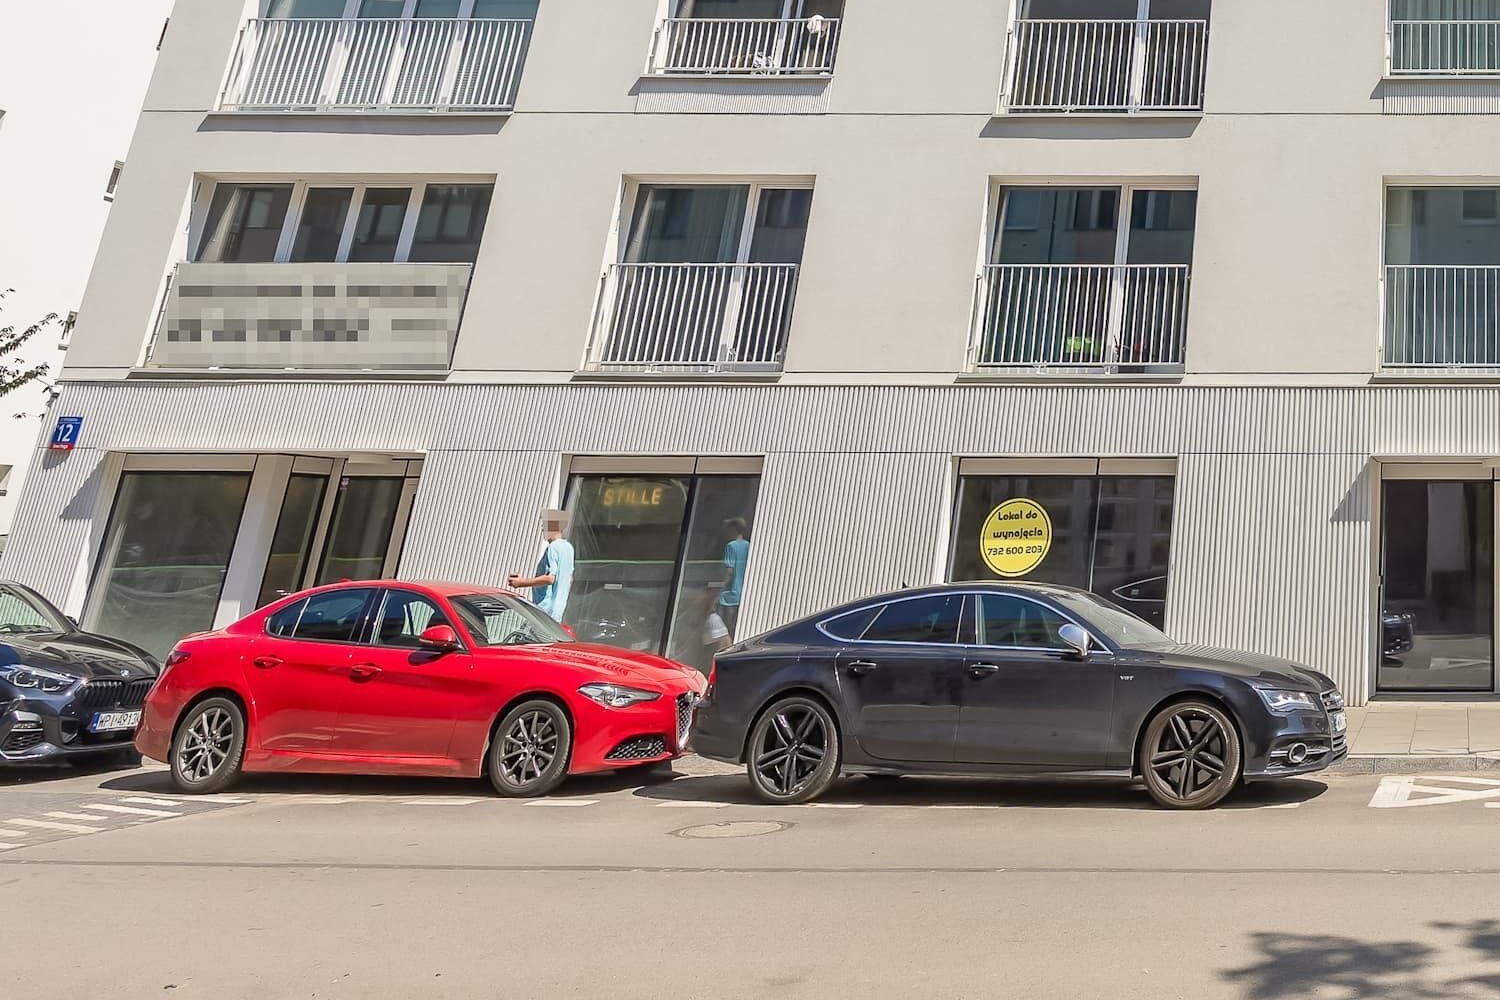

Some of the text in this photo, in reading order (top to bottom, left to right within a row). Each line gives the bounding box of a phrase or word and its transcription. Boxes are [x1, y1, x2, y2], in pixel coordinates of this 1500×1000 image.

[57, 423, 74, 442] 12
[998, 510, 1038, 521] Lokal do
[988, 546, 1004, 556] 732
